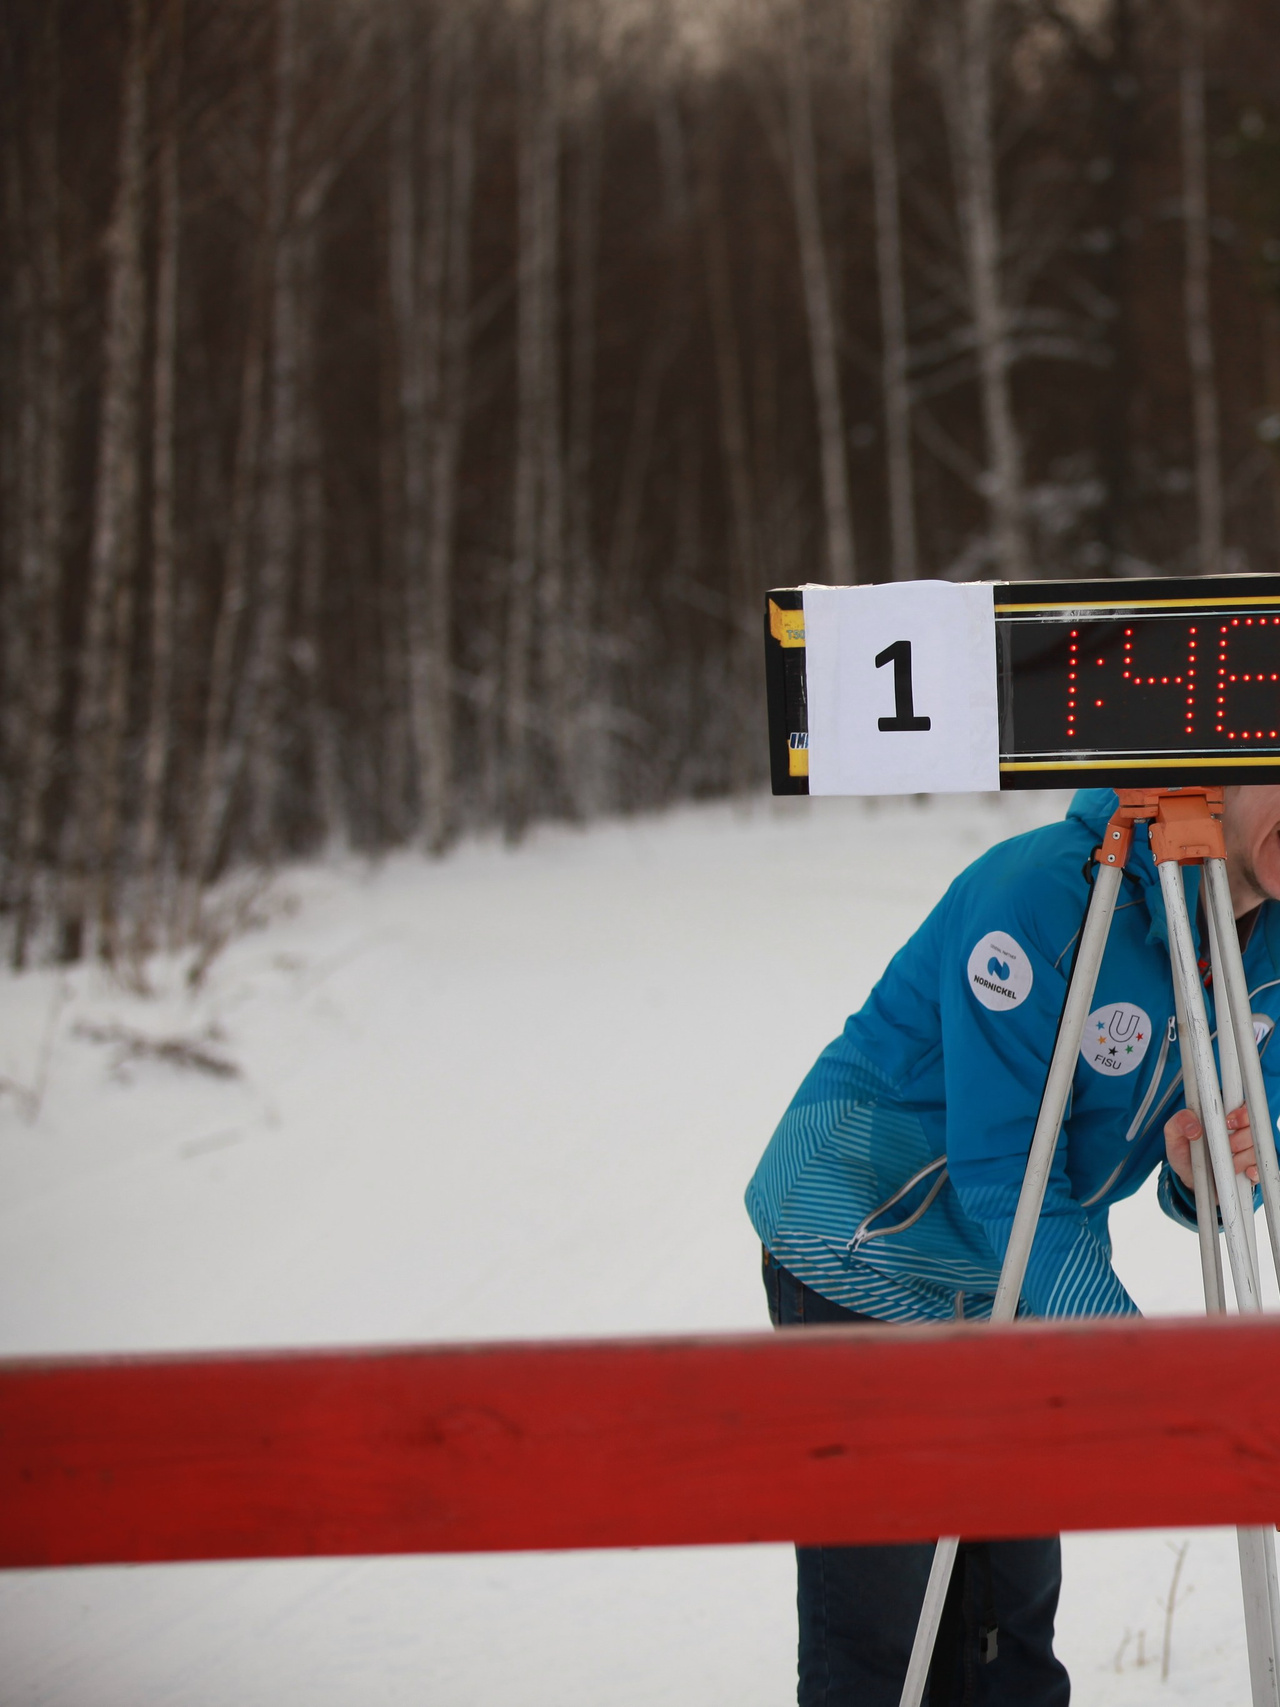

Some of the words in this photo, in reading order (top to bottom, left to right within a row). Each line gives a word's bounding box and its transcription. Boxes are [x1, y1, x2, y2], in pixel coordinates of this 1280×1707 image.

[875, 640, 932, 732] 1
[973, 974, 1017, 1000] NORNICKEL
[1108, 1010, 1140, 1043] U
[1094, 1054, 1122, 1070] FISU
